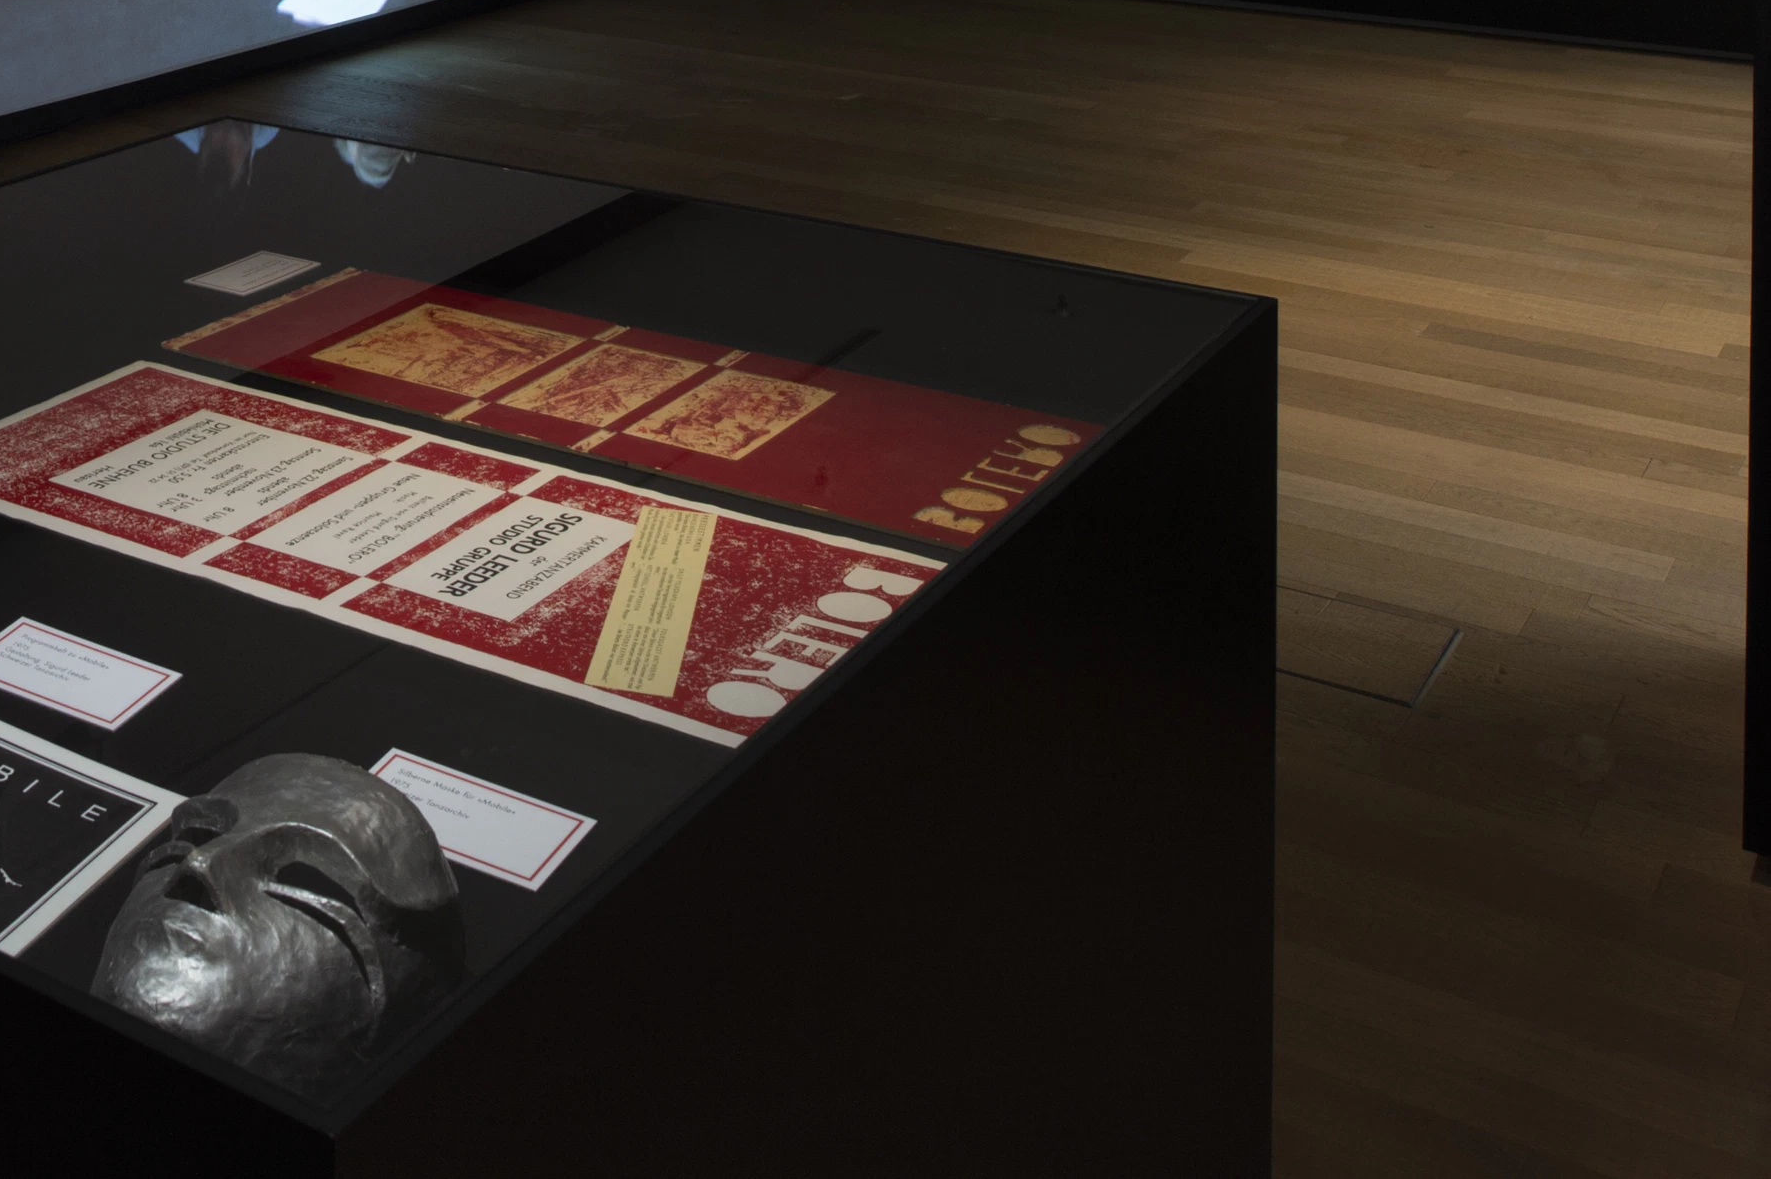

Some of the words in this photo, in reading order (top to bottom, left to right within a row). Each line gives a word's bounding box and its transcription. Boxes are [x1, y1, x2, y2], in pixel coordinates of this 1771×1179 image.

[201, 422, 231, 435] DIE
[150, 433, 206, 459] STUDIO
[87, 459, 153, 489] BUEHNE
[211, 464, 243, 479] abends
[392, 473, 421, 486] Neue
[257, 476, 289, 493] abends
[156, 497, 180, 508] Uhr
[170, 501, 194, 512] Uhr
[202, 511, 226, 522] Uhr
[333, 509, 353, 520] und
[488, 514, 543, 545] STUDIO
[510, 512, 582, 554] SIGURD
[430, 547, 491, 580] GRUPPE
[506, 535, 606, 598] KAMMERTANZABEND
[530, 556, 547, 566] der
[437, 554, 518, 596] LEEDER
[707, 566, 925, 717] BOLERO
[389, 777, 410, 789] 1975
[397, 767, 431, 786] Silberne
[433, 781, 461, 796] Maske
[426, 798, 470, 820] Tanzarchiv
